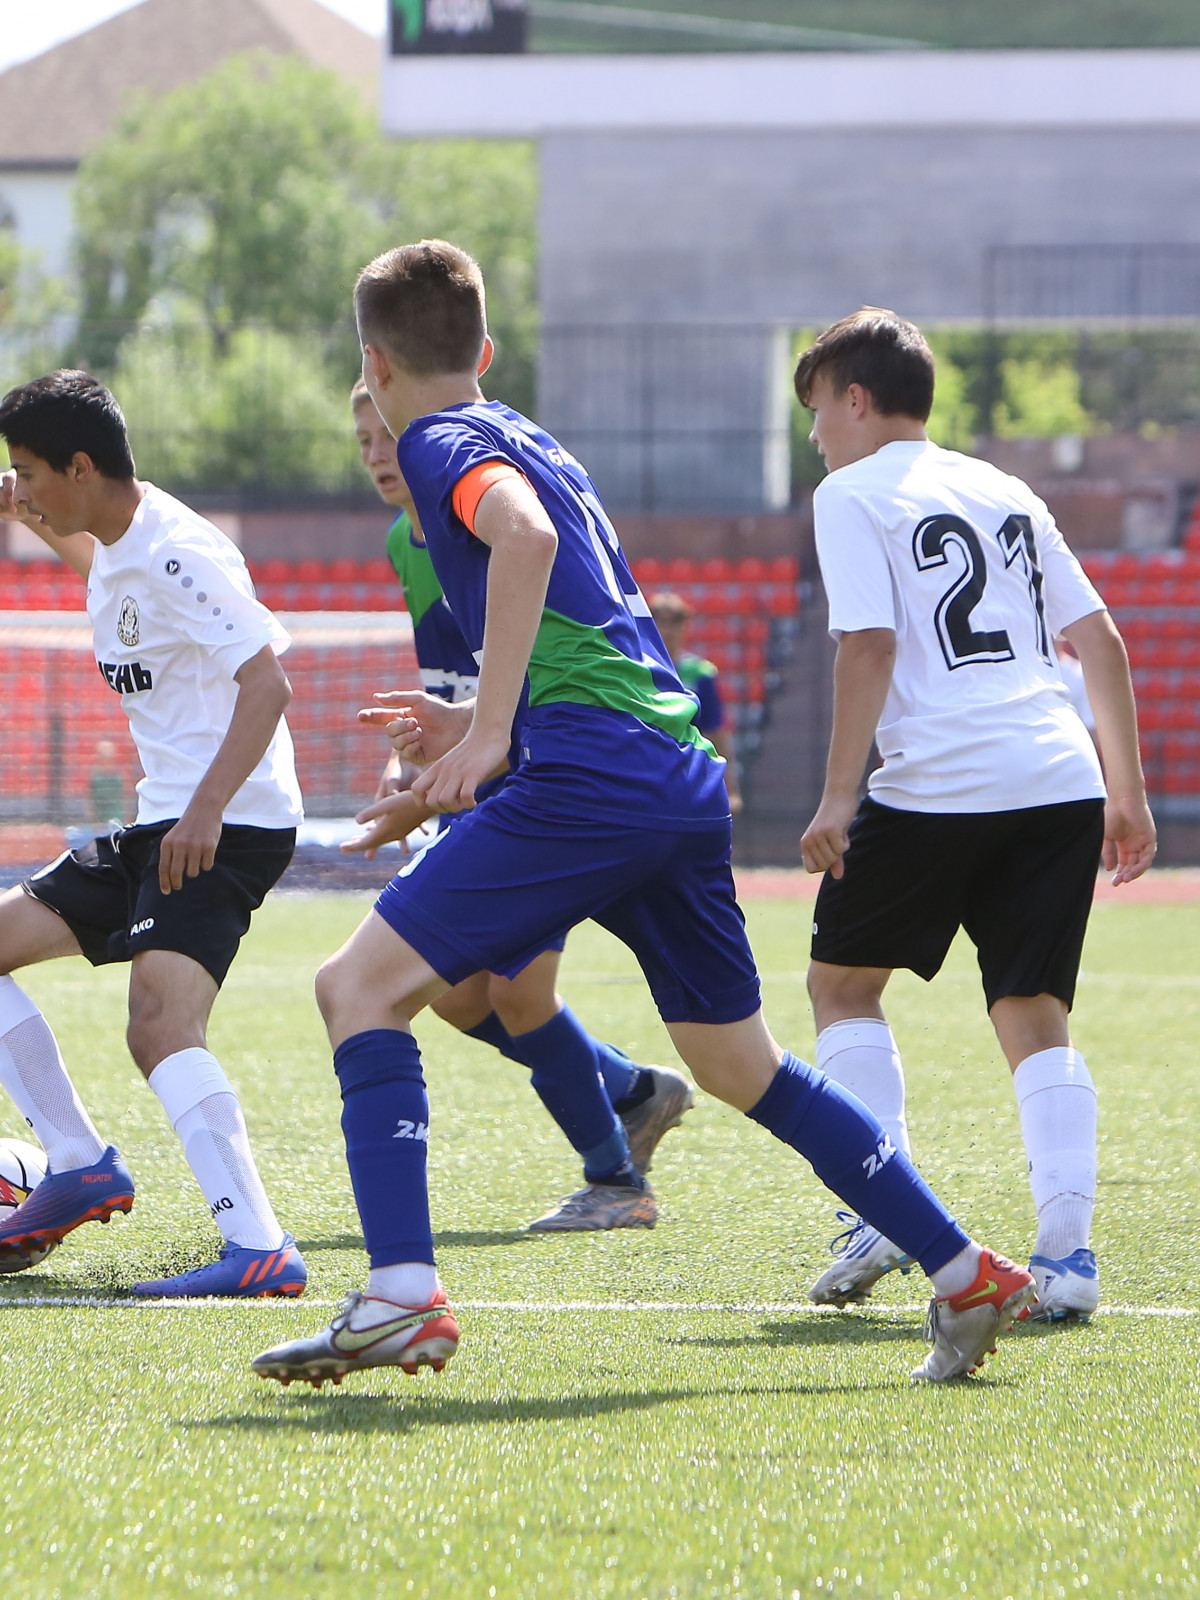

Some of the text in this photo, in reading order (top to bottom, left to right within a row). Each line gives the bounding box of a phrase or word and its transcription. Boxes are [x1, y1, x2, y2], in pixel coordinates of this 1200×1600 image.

[912, 513, 1054, 672] 21
[130, 917, 156, 937] AKO
[210, 1196, 235, 1219] AKO
